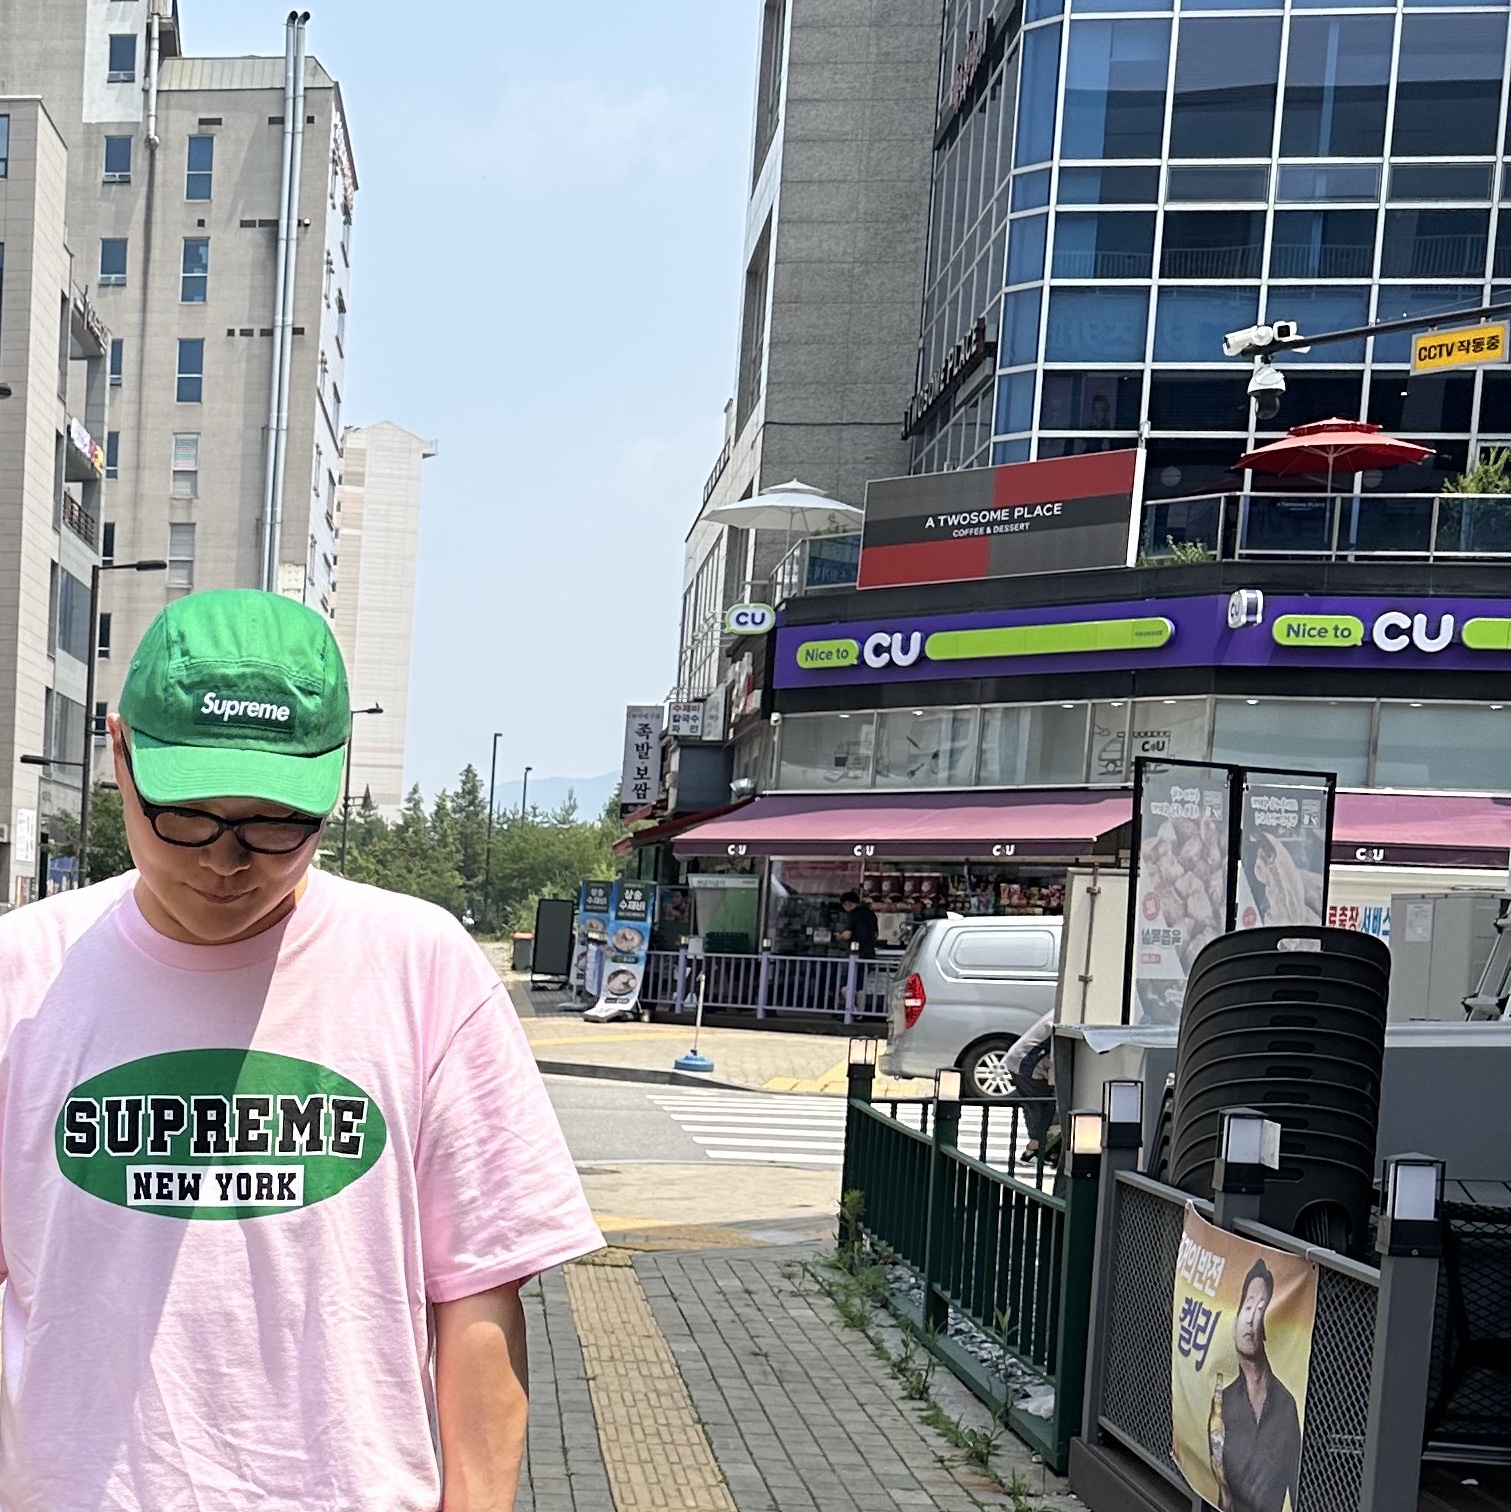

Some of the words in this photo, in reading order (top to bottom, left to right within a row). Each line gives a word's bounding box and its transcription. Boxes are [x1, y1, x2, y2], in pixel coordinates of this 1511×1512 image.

[1418, 344, 1455, 362] CCTV
[1457, 334, 1500, 355] 작동중
[925, 517, 935, 528] A
[938, 508, 1010, 527] TWOSOME
[1014, 503, 1063, 520] PLACE
[952, 527, 984, 538] COFFEE
[993, 522, 1031, 534] DESSERT
[735, 611, 766, 626] CU
[1286, 622, 1328, 639] Nice
[1332, 623, 1353, 639] to
[1372, 611, 1455, 652] CU
[805, 648, 833, 663] Nice
[835, 647, 849, 661] to
[862, 630, 925, 669] CU
[201, 692, 290, 721] Supreme
[672, 714, 700, 724] 칼국수
[727, 844, 747, 856] CU
[853, 844, 875, 857] CU
[992, 844, 1016, 856] CU
[1355, 848, 1385, 861] CU
[64, 1094, 369, 1158] SUPREME
[133, 1172, 203, 1201] NEW
[215, 1172, 297, 1201] YORK
[1193, 1249, 1226, 1297] 반전
[1178, 1296, 1222, 1372] 켈리
